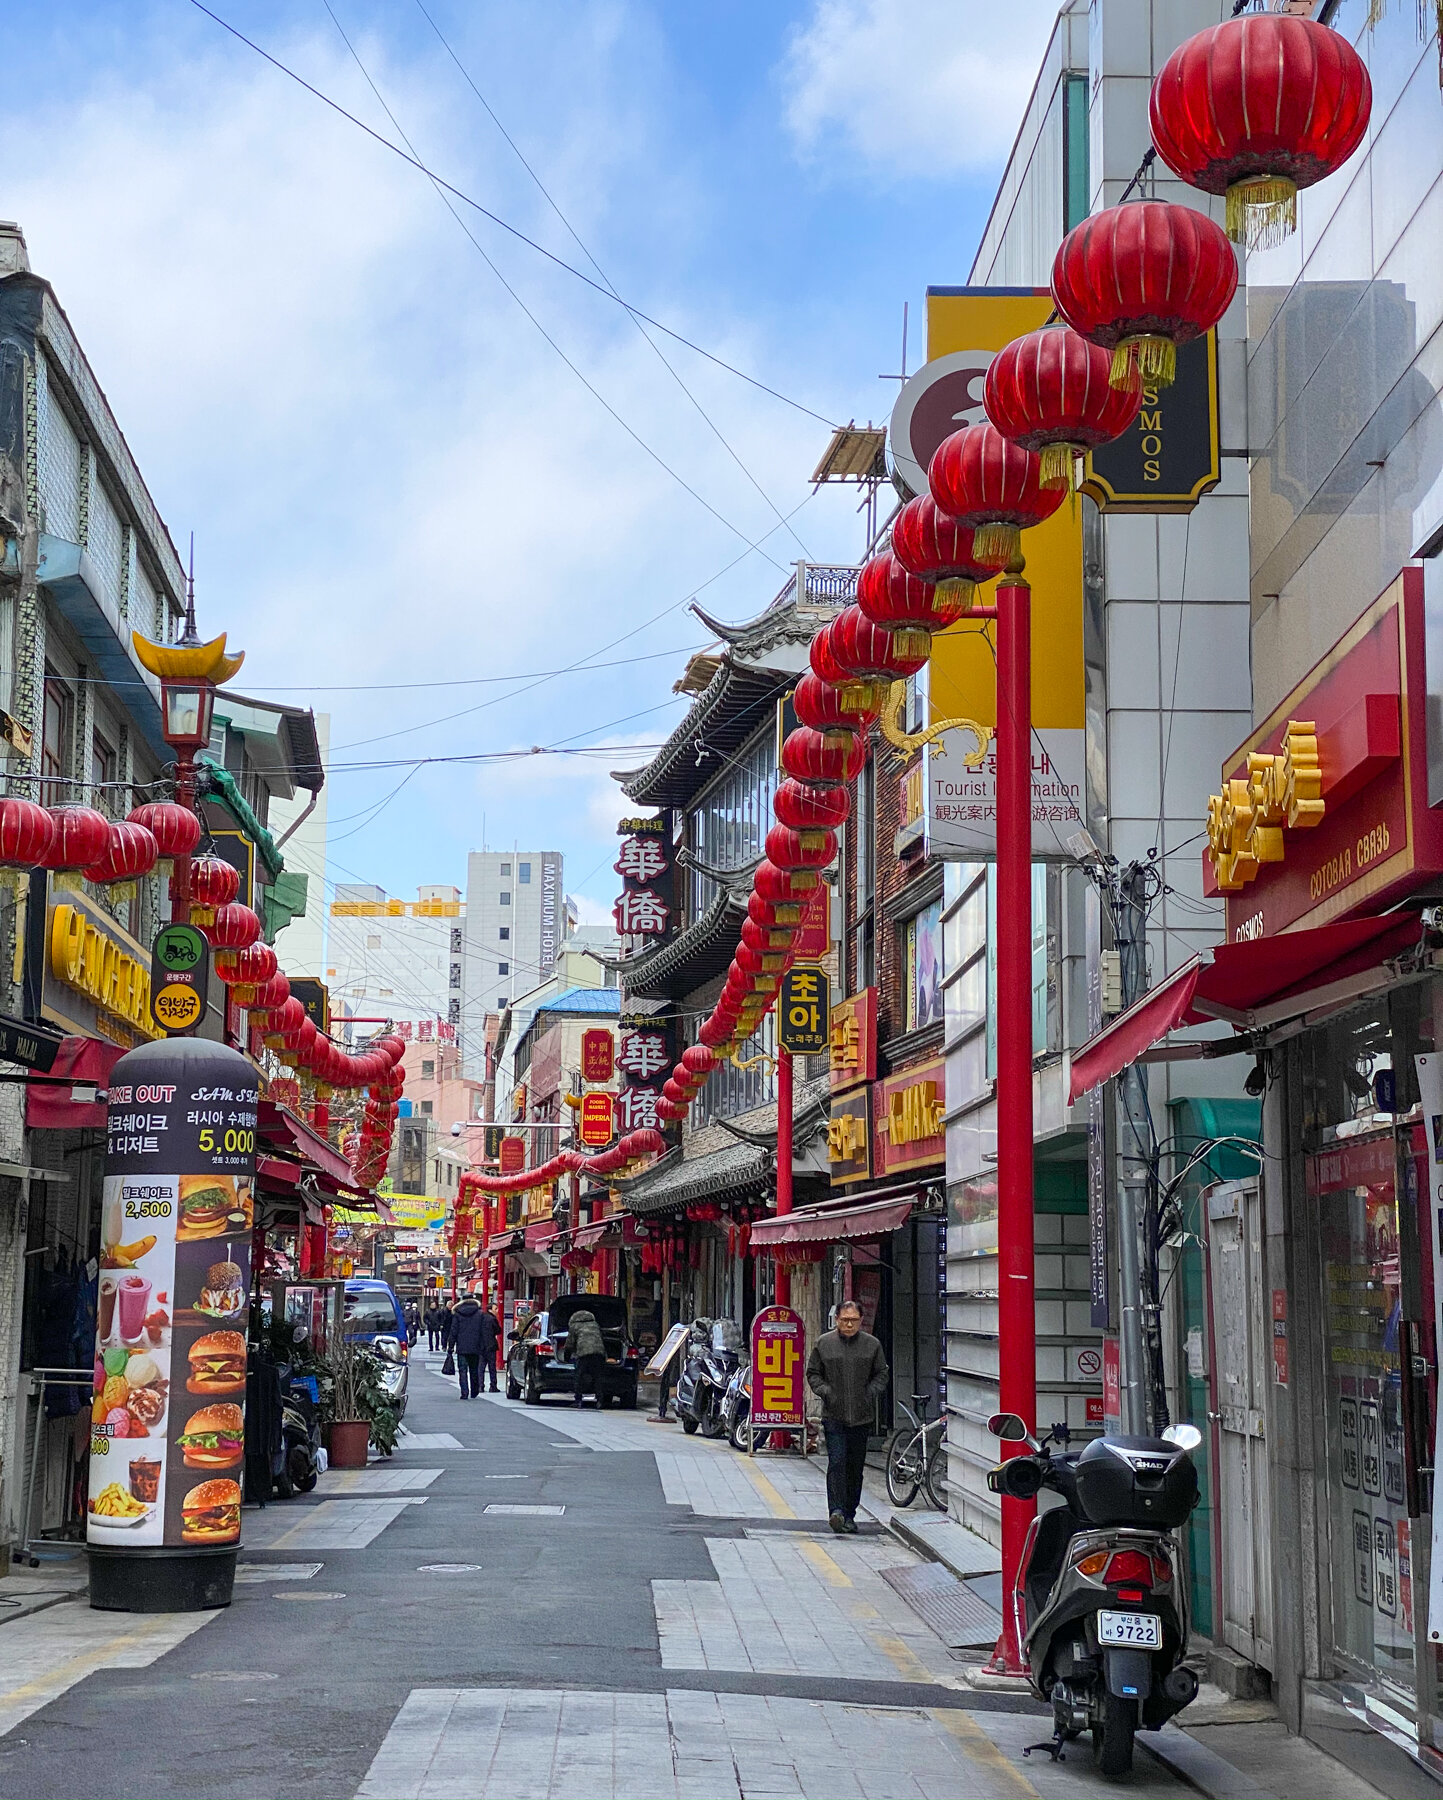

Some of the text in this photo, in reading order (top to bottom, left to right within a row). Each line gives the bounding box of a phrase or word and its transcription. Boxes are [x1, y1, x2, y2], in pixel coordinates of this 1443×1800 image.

[1138, 383, 1163, 481] SMOS
[934, 780, 1079, 797] Tourist Imation
[1032, 805, 1080, 821] 游咨询
[618, 818, 665, 831] 中華料理
[1310, 822, 1390, 900] СОТОВАЯ СВЯЗЬ
[542, 863, 556, 967] MAXIMUM HOTEL
[158, 996, 197, 1008] 이바구
[788, 973, 820, 1033] 초아
[160, 1008, 194, 1019] 자전거
[786, 1034, 823, 1044] 노래주점
[108, 1085, 177, 1104] AKE OUT
[190, 1087, 233, 1101] SAM
[108, 1114, 168, 1133] 밀크쉐이크
[187, 1110, 224, 1126] 러시아
[116, 1136, 160, 1154] 디저트
[199, 1129, 254, 1154] 5,000
[122, 1187, 172, 1199] 밀크쉐이크
[126, 1202, 172, 1219] 2,500
[394, 1247, 447, 1261] TEXAS
[757, 1339, 800, 1412] 발
[1090, 1404, 1103, 1413] 에스
[1136, 1461, 1164, 1469] SHAD
[1120, 1616, 1133, 1624] 부산
[1116, 1625, 1155, 1642] 9722
